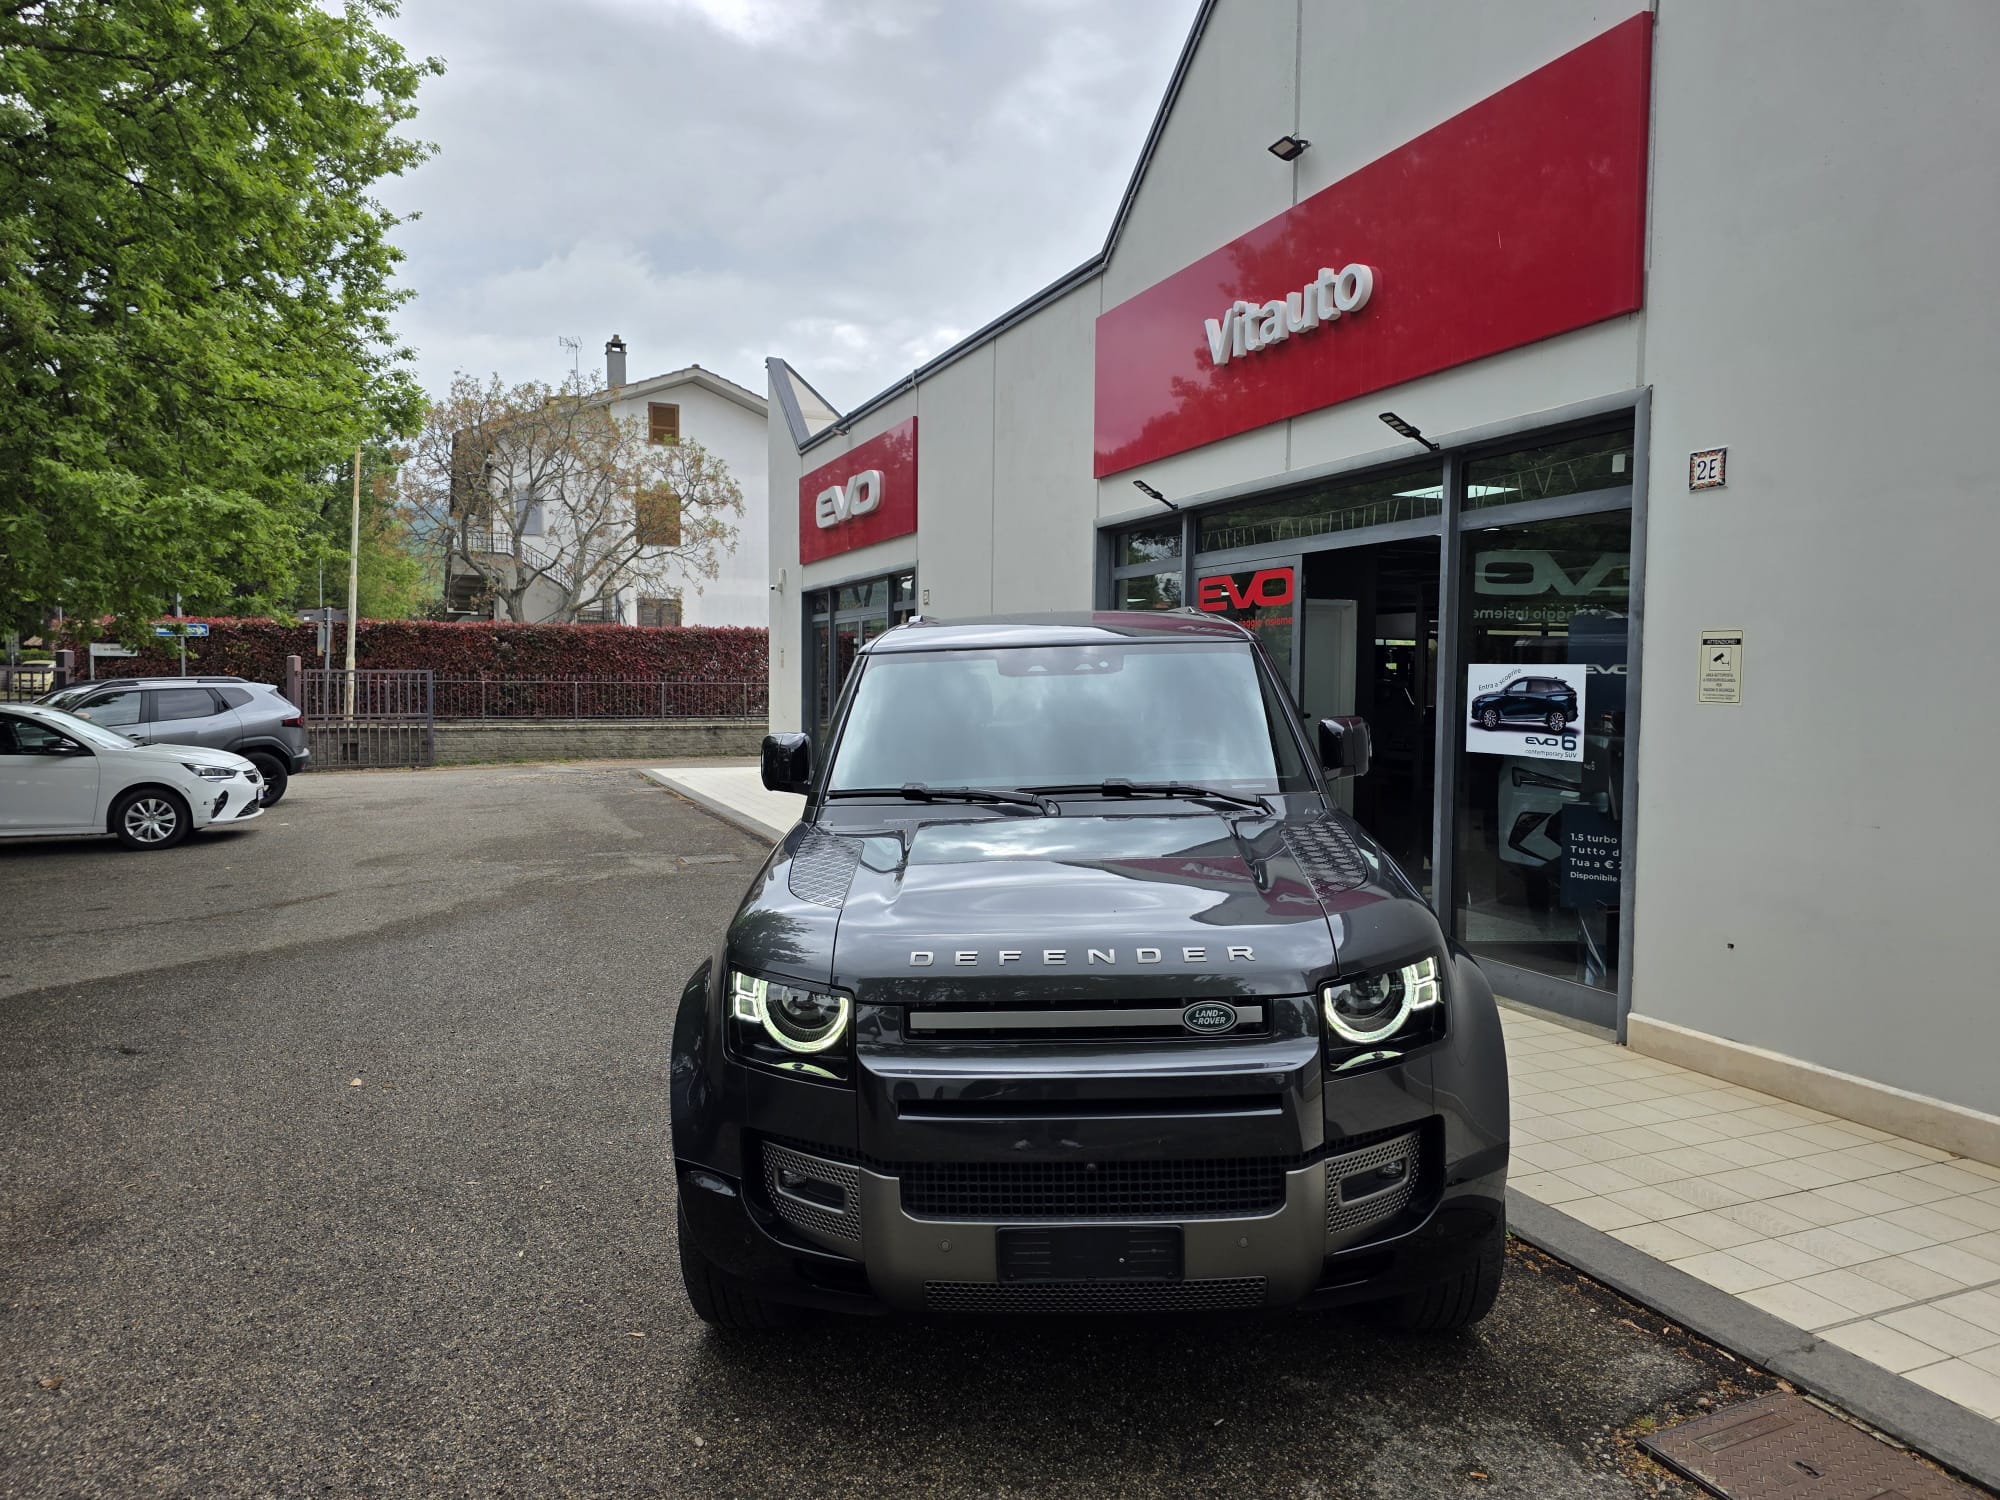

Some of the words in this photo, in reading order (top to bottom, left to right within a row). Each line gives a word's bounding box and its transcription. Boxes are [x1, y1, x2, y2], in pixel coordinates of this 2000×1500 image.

[1204, 263, 1373, 365] Vitauto
[1697, 458, 1718, 480] 2E
[816, 470, 881, 528] EVO
[1198, 567, 1294, 611] EVO
[1478, 682, 1494, 691] Entra
[1499, 668, 1522, 685] scoprire
[1525, 736, 1559, 747] EVO
[1561, 733, 1577, 751] 6
[1525, 749, 1564, 758] contemporary
[1570, 833, 1584, 841] 1.5
[1587, 834, 1618, 844] turbo
[1570, 846, 1606, 855] Tutto
[1570, 858, 1590, 867] Tua
[1570, 871, 1618, 882] Disponibile
[909, 946, 1256, 967] DEFENDER
